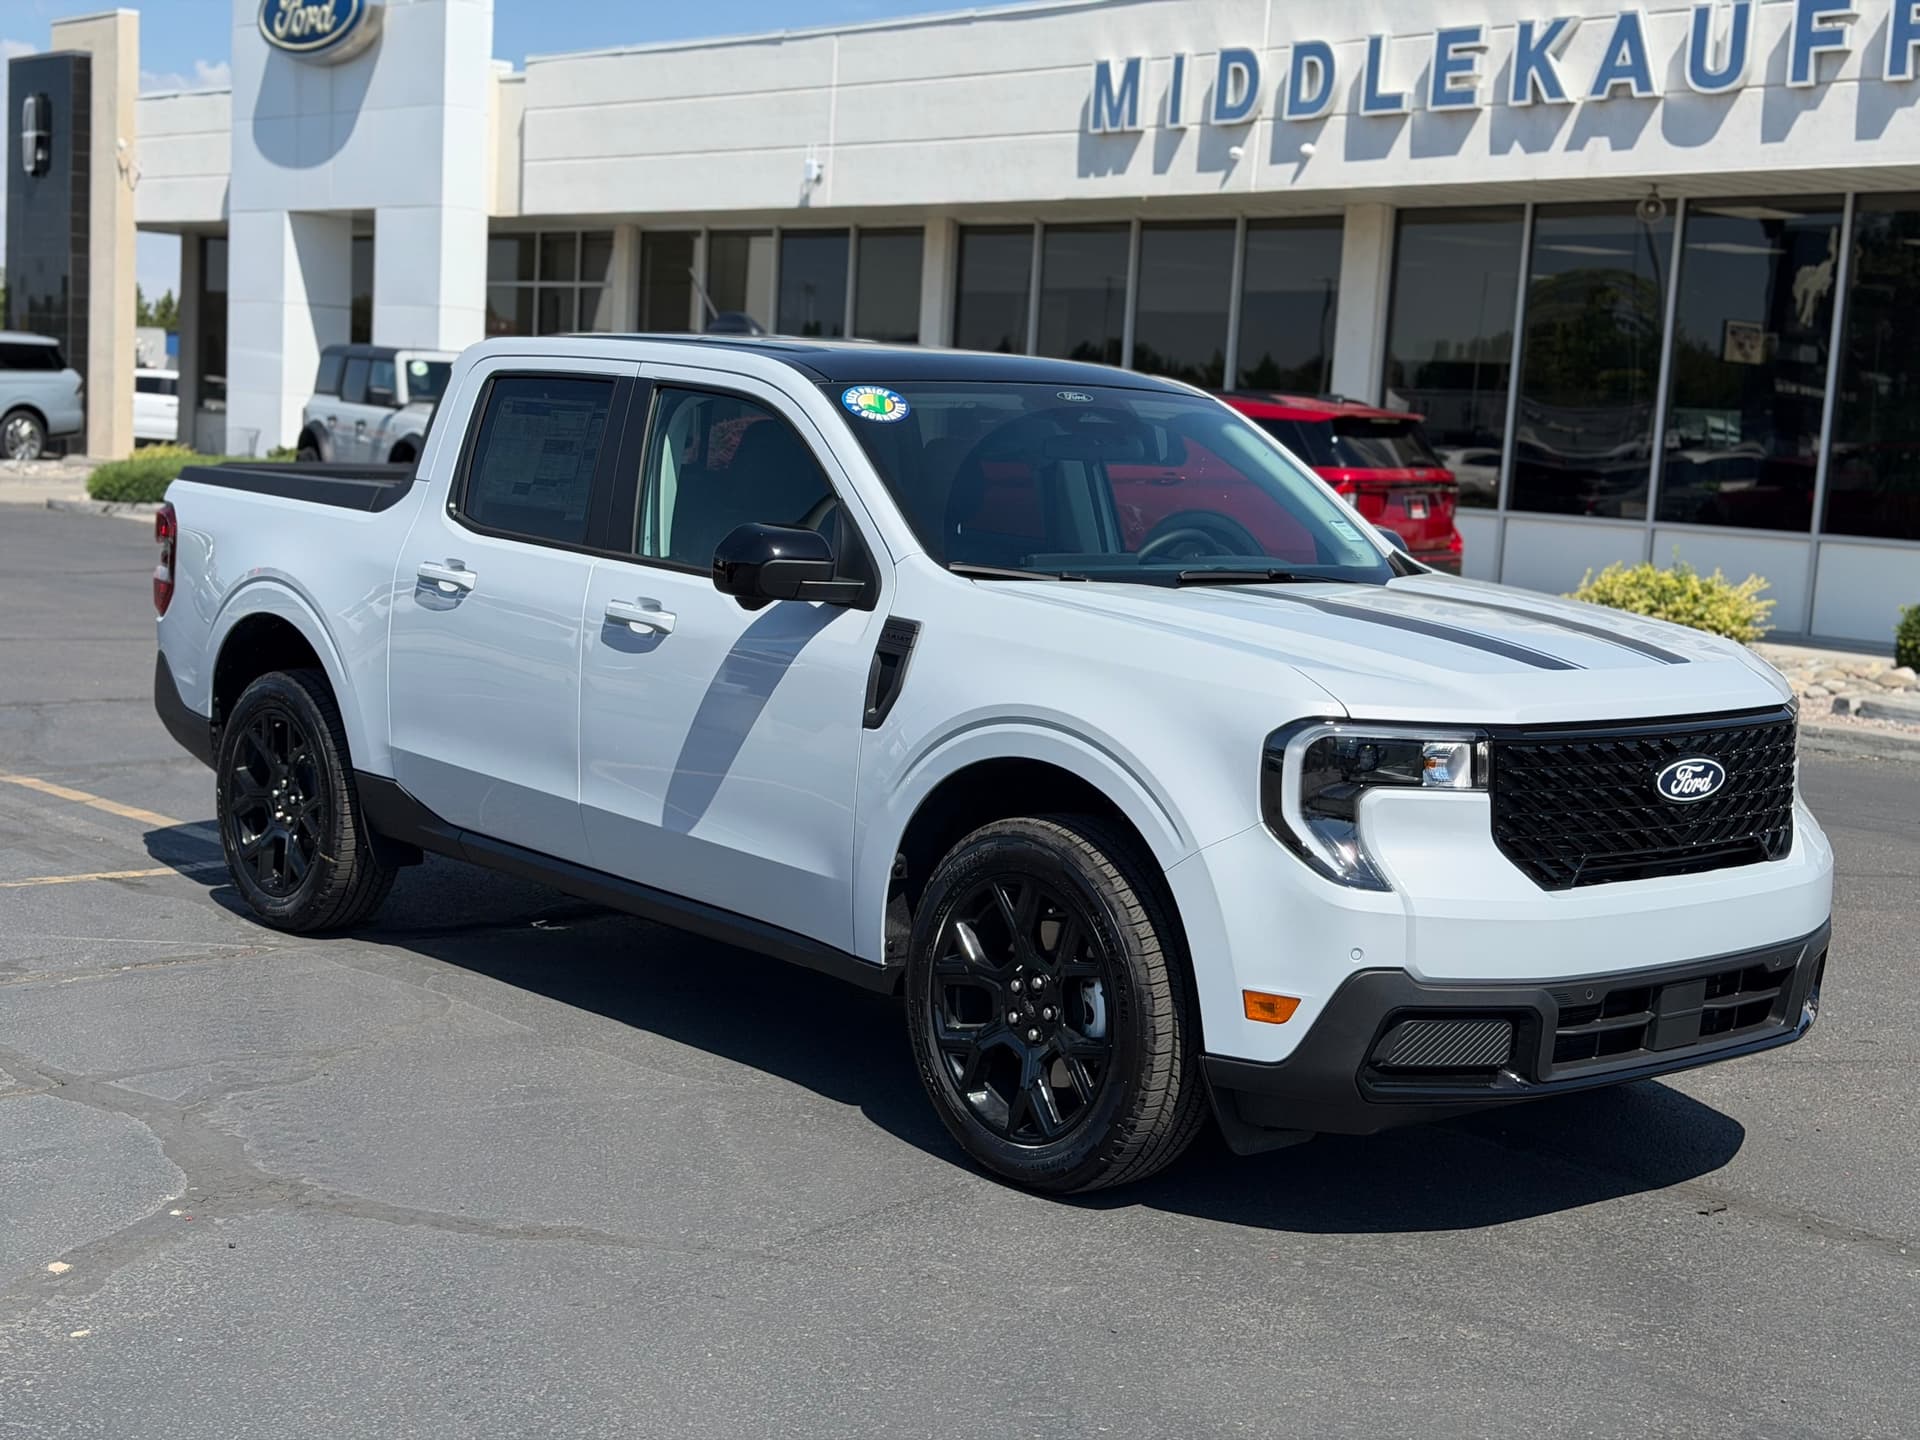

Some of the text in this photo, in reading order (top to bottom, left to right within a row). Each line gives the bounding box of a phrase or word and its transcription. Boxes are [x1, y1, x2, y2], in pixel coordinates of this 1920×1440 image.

[273, 0, 337, 39] Ford
[857, 387, 890, 398] PRICE
[1060, 391, 1090, 401] Ford
[1670, 765, 1715, 795] Ford
